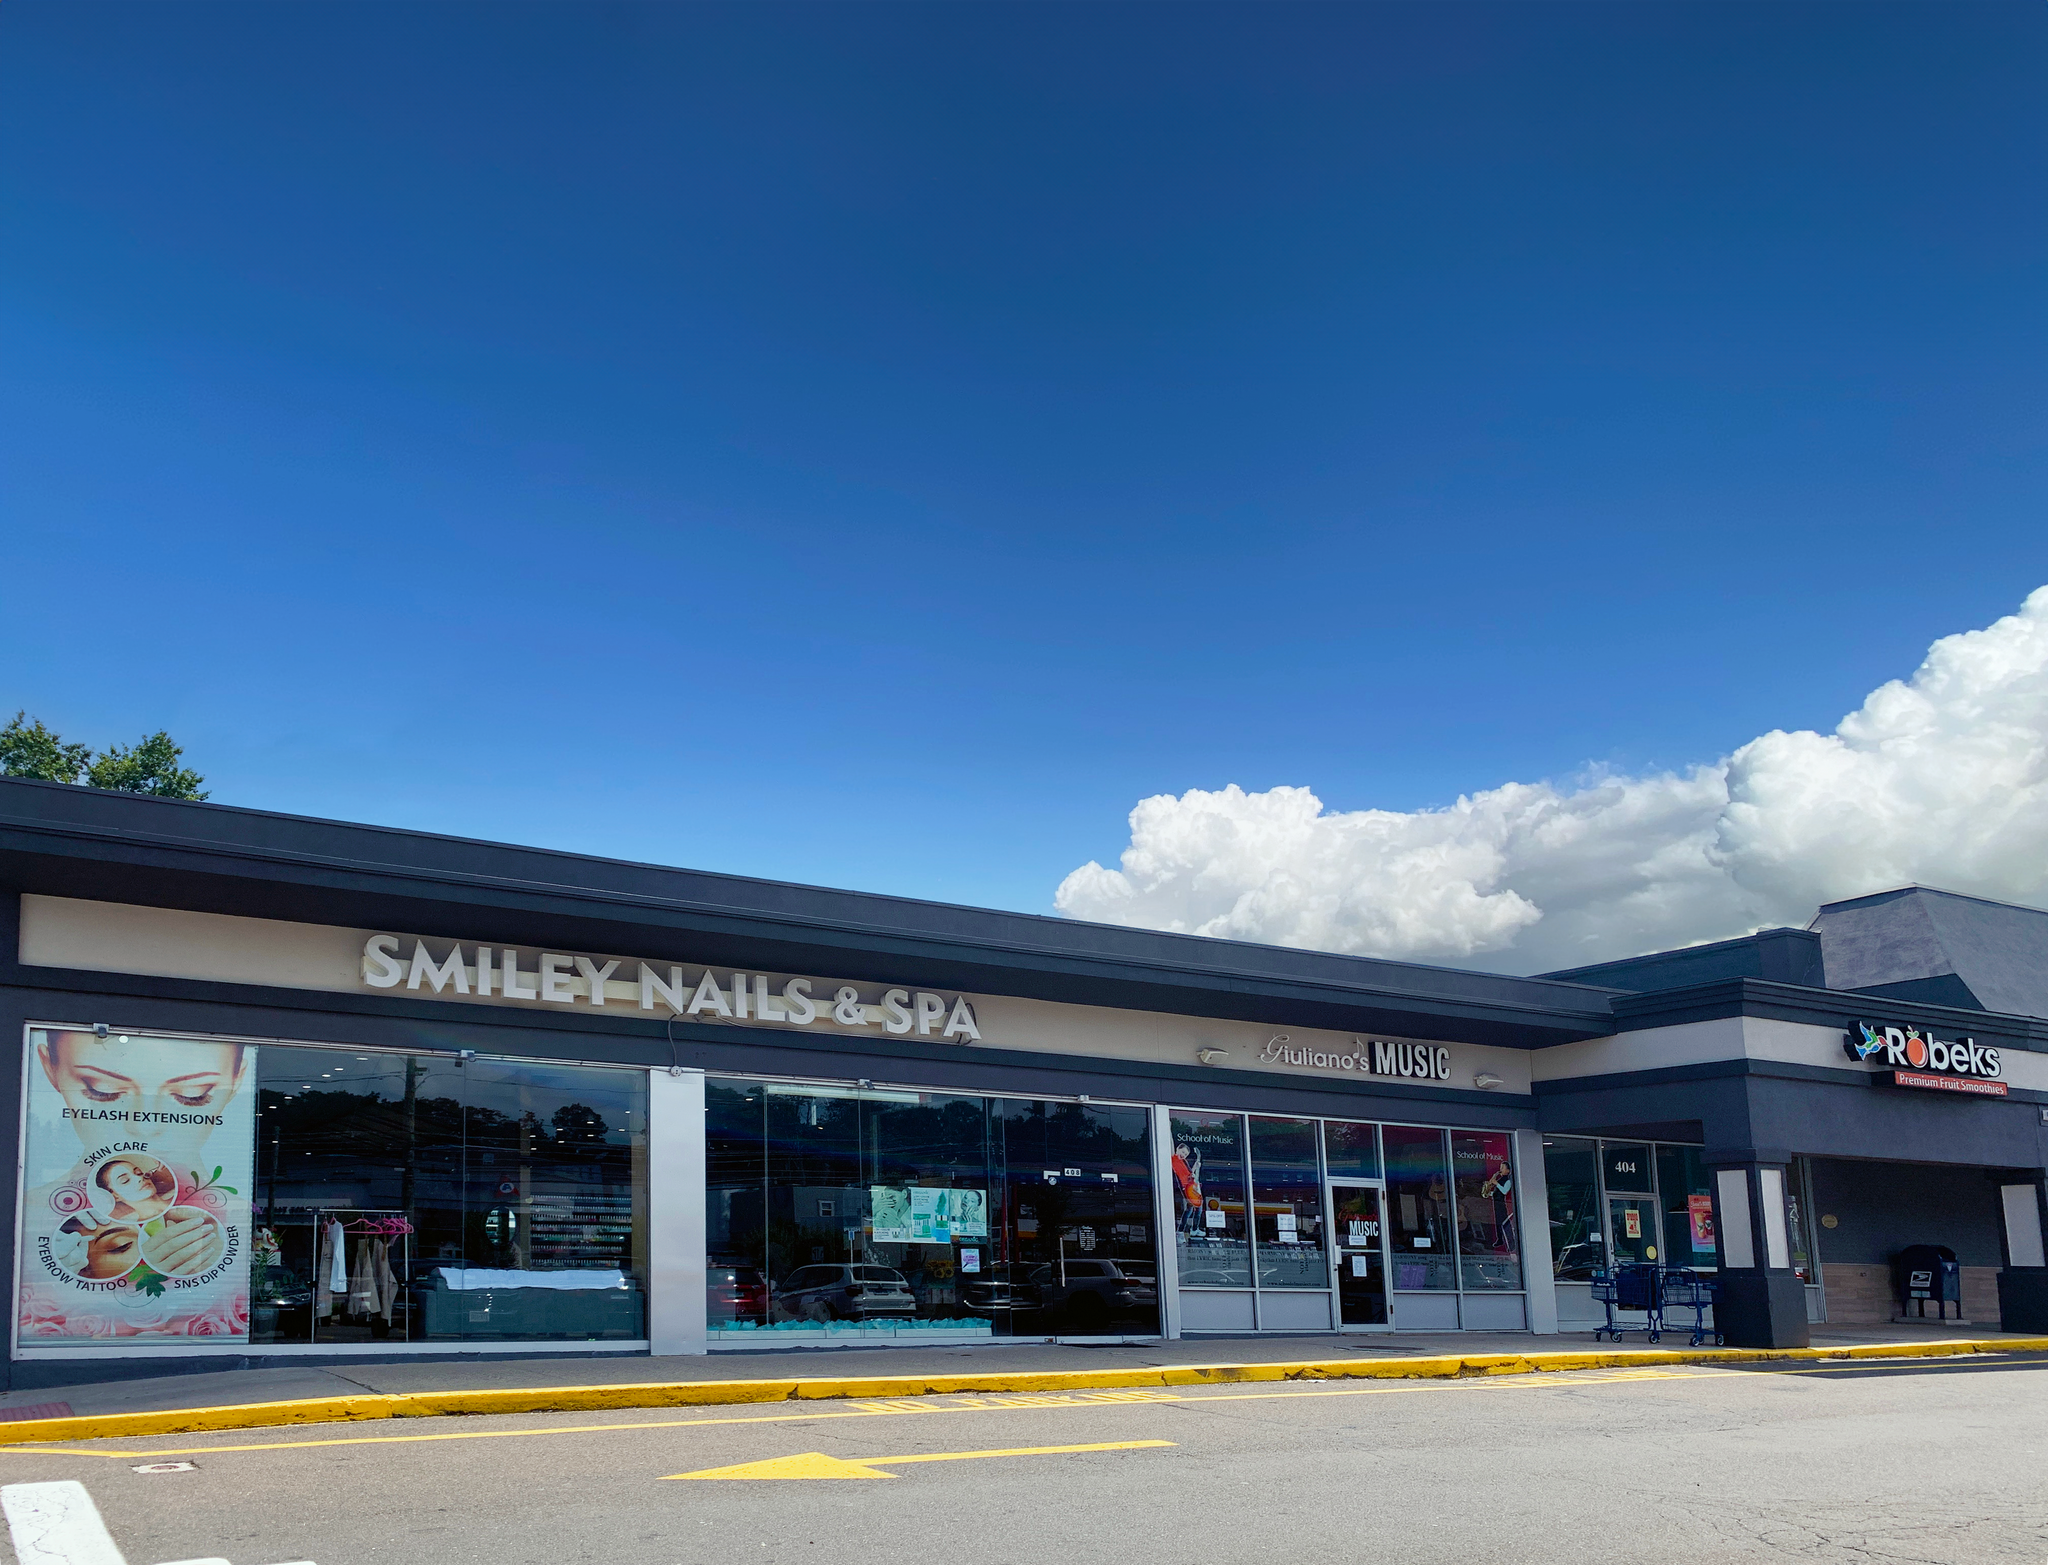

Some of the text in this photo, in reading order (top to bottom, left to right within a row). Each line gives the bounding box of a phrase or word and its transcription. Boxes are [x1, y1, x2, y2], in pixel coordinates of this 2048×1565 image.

[363, 934, 982, 1040] SMILEY NAILS & SPA
[1372, 1041, 1451, 1080] MUSIC
[1885, 1025, 2002, 1077] Robeks
[1899, 1073, 2004, 1095] Premium Fruit Smoothies
[62, 1108, 224, 1126] EYELASH EXTENSIONS
[1177, 1132, 1234, 1145] School of Music
[83, 1141, 149, 1168] SKIN CARE
[1456, 1150, 1504, 1161] School of Music
[1065, 1168, 1080, 1176] 408
[1615, 1161, 1636, 1173] 404
[1349, 1220, 1379, 1237] MUSIC
[37, 1236, 128, 1292] EYEBROW TATTOO
[174, 1224, 240, 1290] SNS DIP POWDER
[844, 1391, 1182, 1412] NO PARKING
